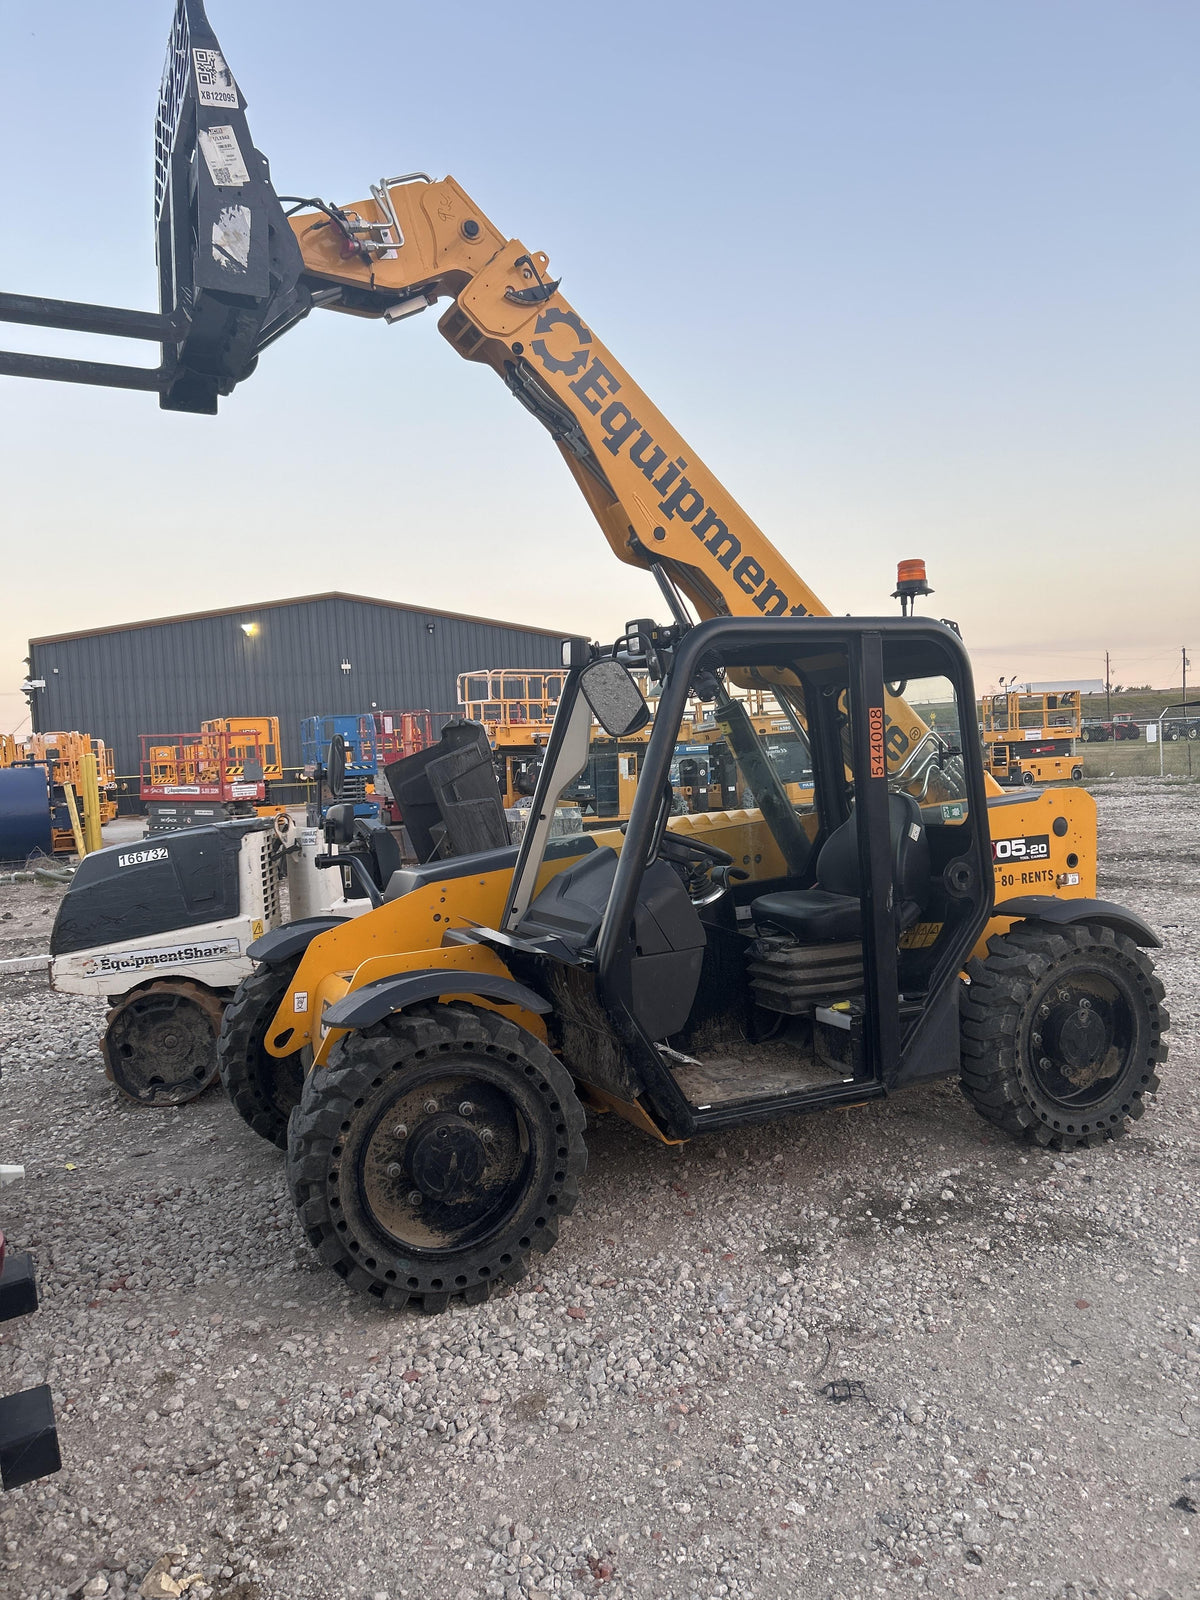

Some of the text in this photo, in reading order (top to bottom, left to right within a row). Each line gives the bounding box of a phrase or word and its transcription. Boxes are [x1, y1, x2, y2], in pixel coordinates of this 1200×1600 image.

[200, 90, 236, 103] XB122095
[870, 709, 884, 776] 544008
[119, 847, 168, 866] 166732
[996, 839, 1047, 858] 05-20
